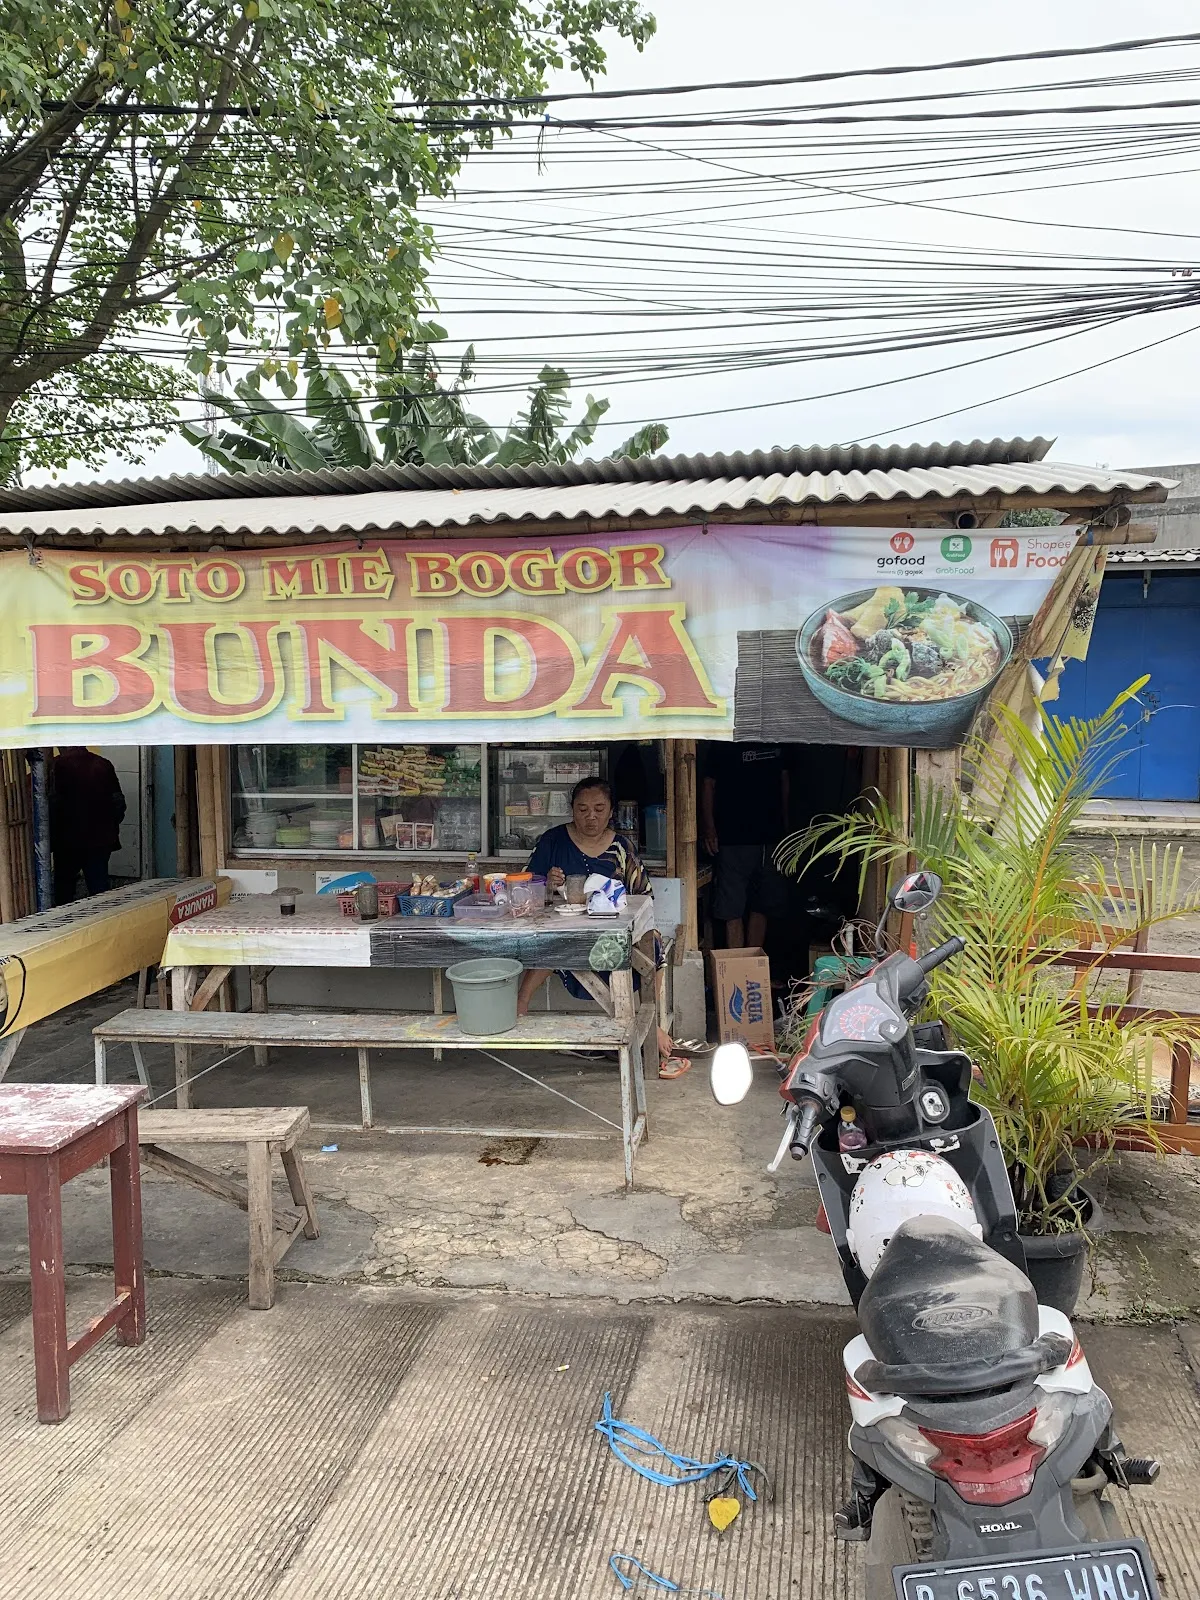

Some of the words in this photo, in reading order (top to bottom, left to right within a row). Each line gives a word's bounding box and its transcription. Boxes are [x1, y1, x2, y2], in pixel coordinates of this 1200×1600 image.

[877, 556, 925, 568] gofood
[1027, 538, 1070, 552] Shopee
[68, 559, 244, 604] SOTO
[265, 549, 393, 599] MIE
[411, 544, 669, 597] BOGOR
[24, 605, 726, 723] BUNDA
[177, 893, 214, 919] HANURA
[745, 979, 763, 1024] AQUA
